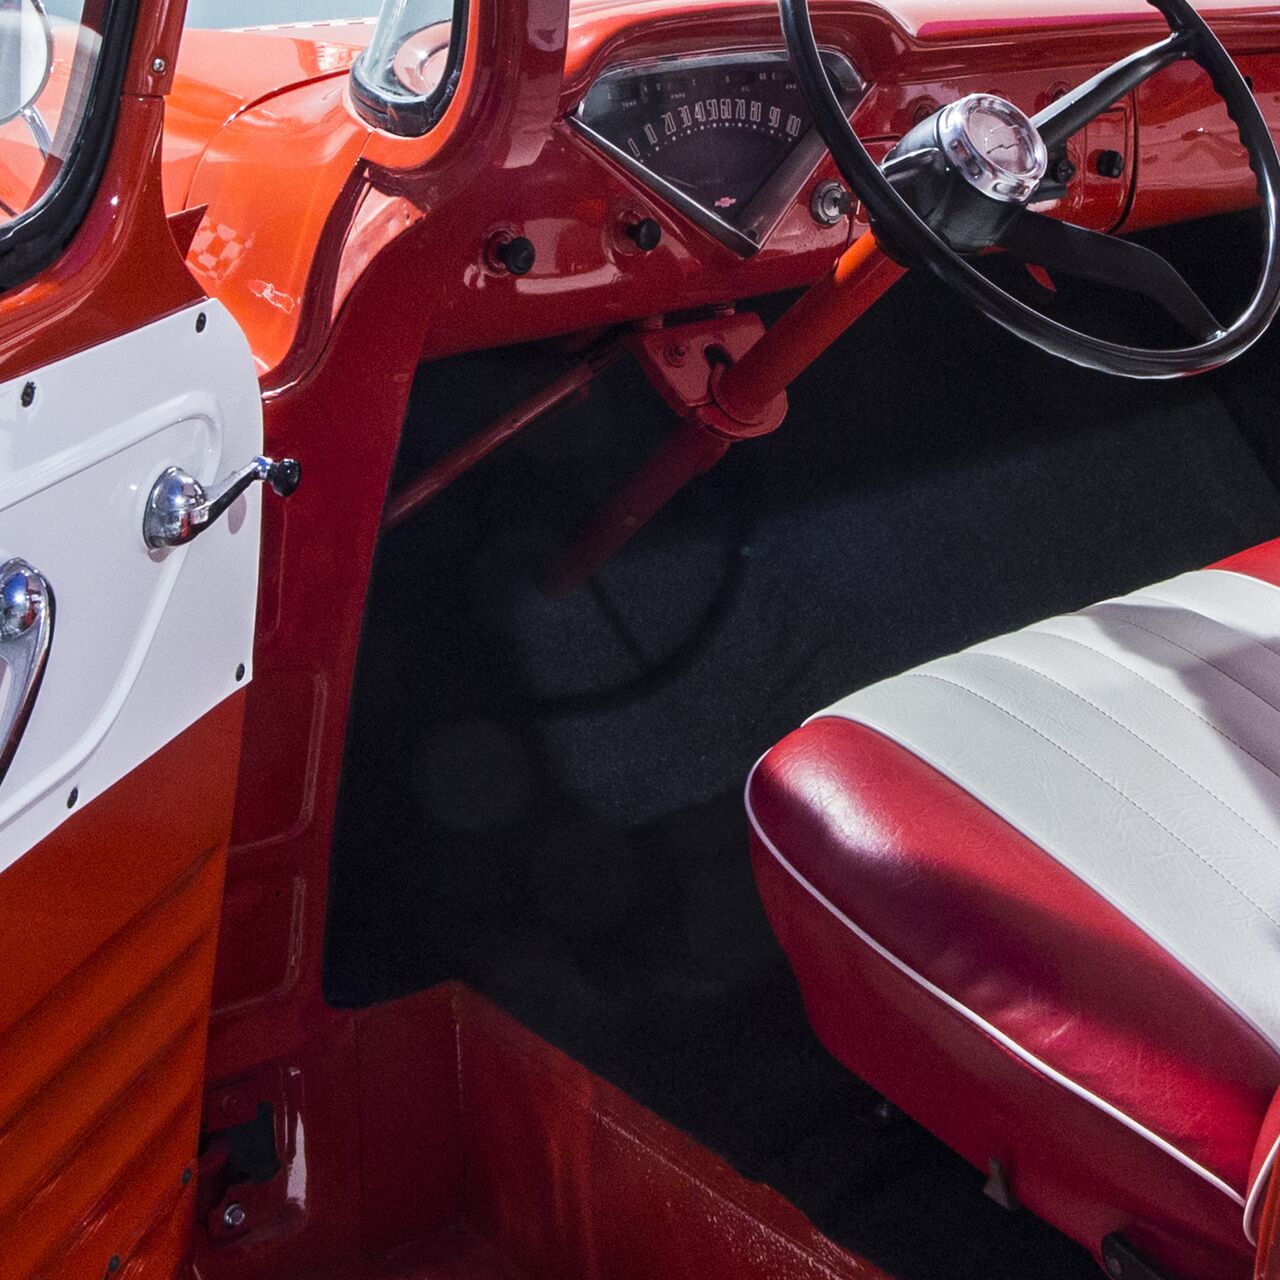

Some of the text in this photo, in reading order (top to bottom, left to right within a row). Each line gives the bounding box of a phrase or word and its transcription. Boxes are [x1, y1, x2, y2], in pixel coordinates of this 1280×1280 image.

[627, 98, 802, 158] 0 10 20 30 40 50 60 70 80 90 100
